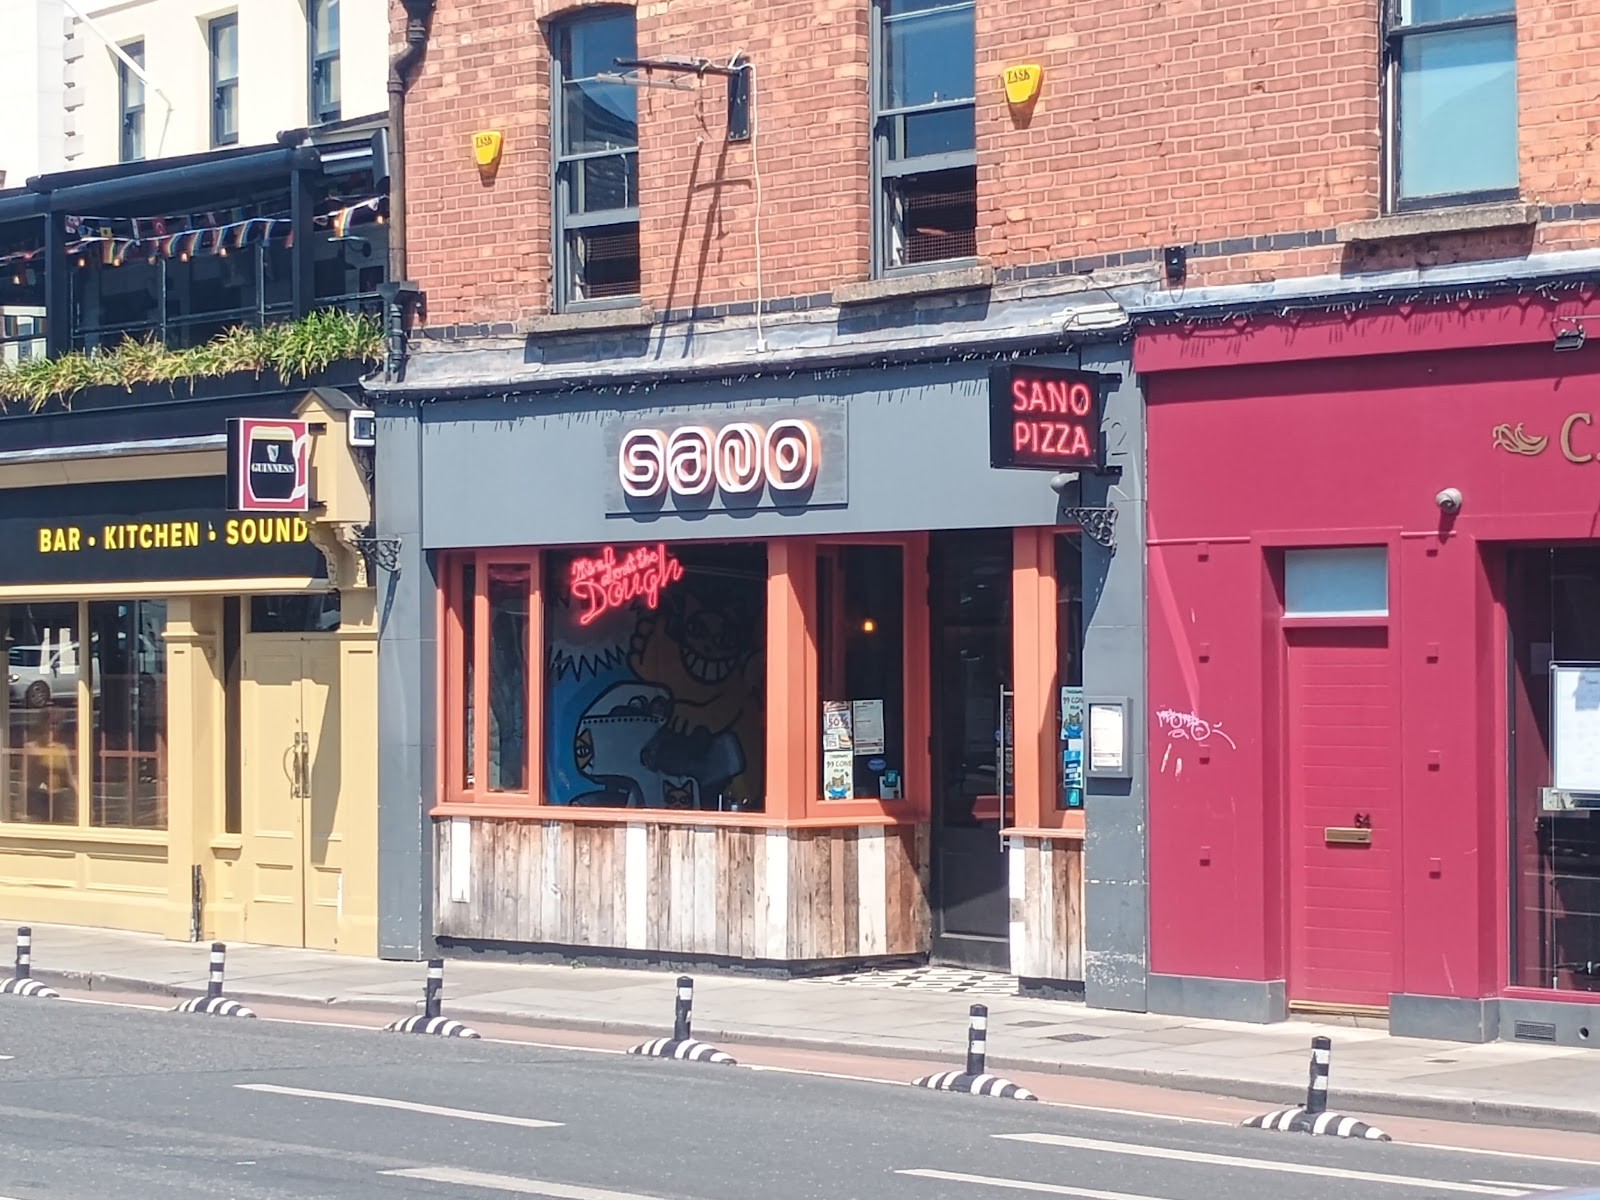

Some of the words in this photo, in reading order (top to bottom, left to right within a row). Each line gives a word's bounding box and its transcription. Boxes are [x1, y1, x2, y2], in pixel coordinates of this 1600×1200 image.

[1013, 380, 1090, 415] SANO
[1014, 421, 1091, 457] PIZZA
[251, 463, 295, 473] GUINNESS
[39, 527, 81, 553] BAR
[104, 521, 199, 550] KITCHEN
[226, 516, 308, 545] SOUND
